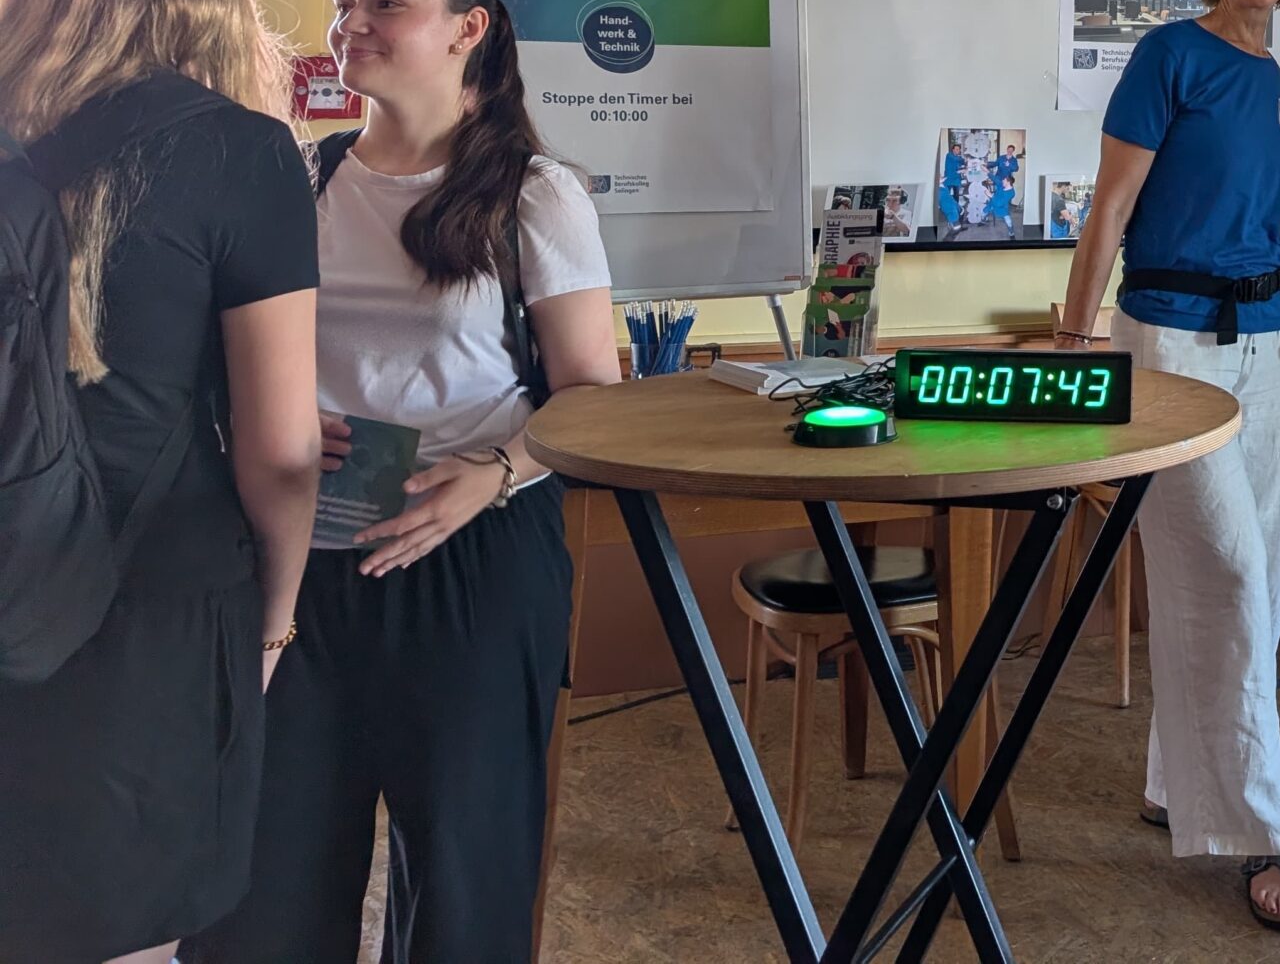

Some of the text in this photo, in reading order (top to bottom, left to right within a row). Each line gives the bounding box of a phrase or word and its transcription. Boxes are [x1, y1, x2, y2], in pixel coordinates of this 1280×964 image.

[600, 15, 633, 26] Hand-
[597, 28, 637, 39] werk &
[599, 41, 640, 52] Technik
[542, 92, 693, 106] Stoppe den Timer bei
[590, 110, 648, 122] 00:10:00
[918, 366, 1110, 407] 00:07:43
